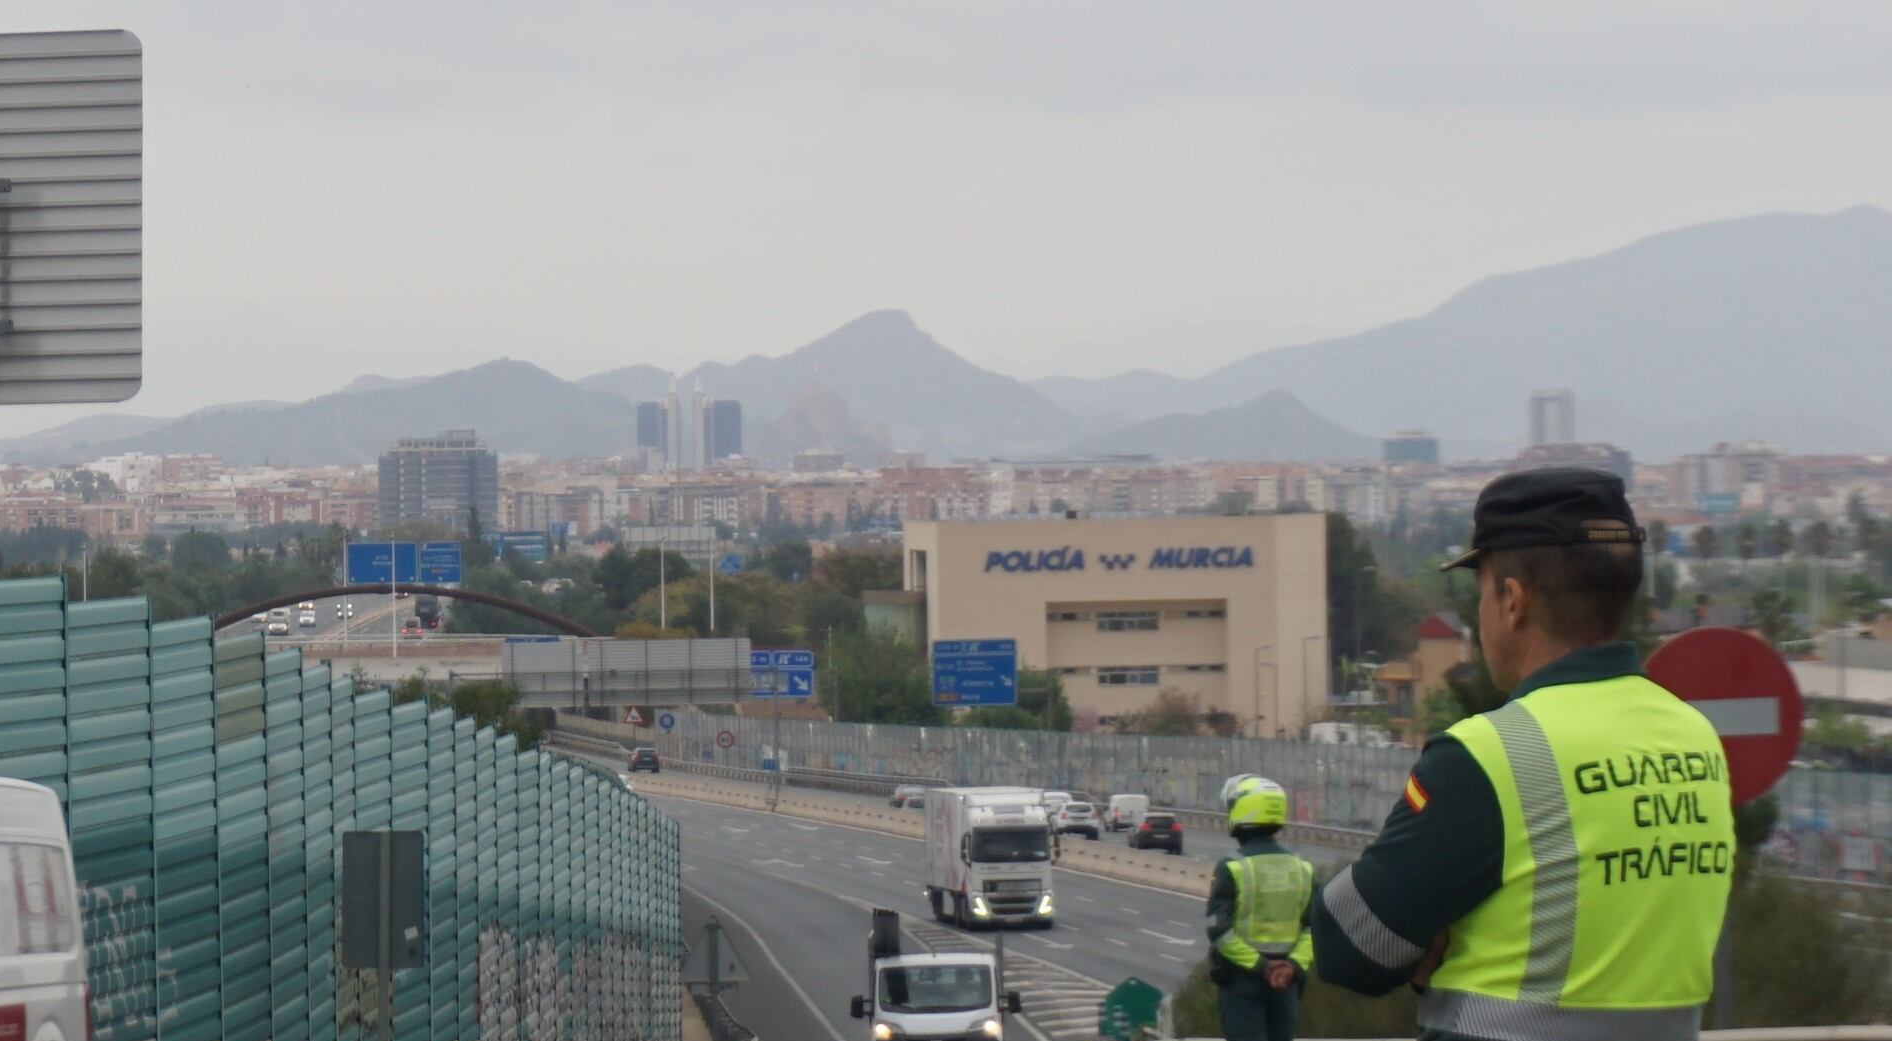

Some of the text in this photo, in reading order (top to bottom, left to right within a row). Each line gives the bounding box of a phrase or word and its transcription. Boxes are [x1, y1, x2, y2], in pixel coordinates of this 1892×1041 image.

[984, 546, 1254, 573] POLICÍA MURCIA
[1634, 791, 1708, 828] CIVIL
[1596, 837, 1728, 886] TRÁFICO
